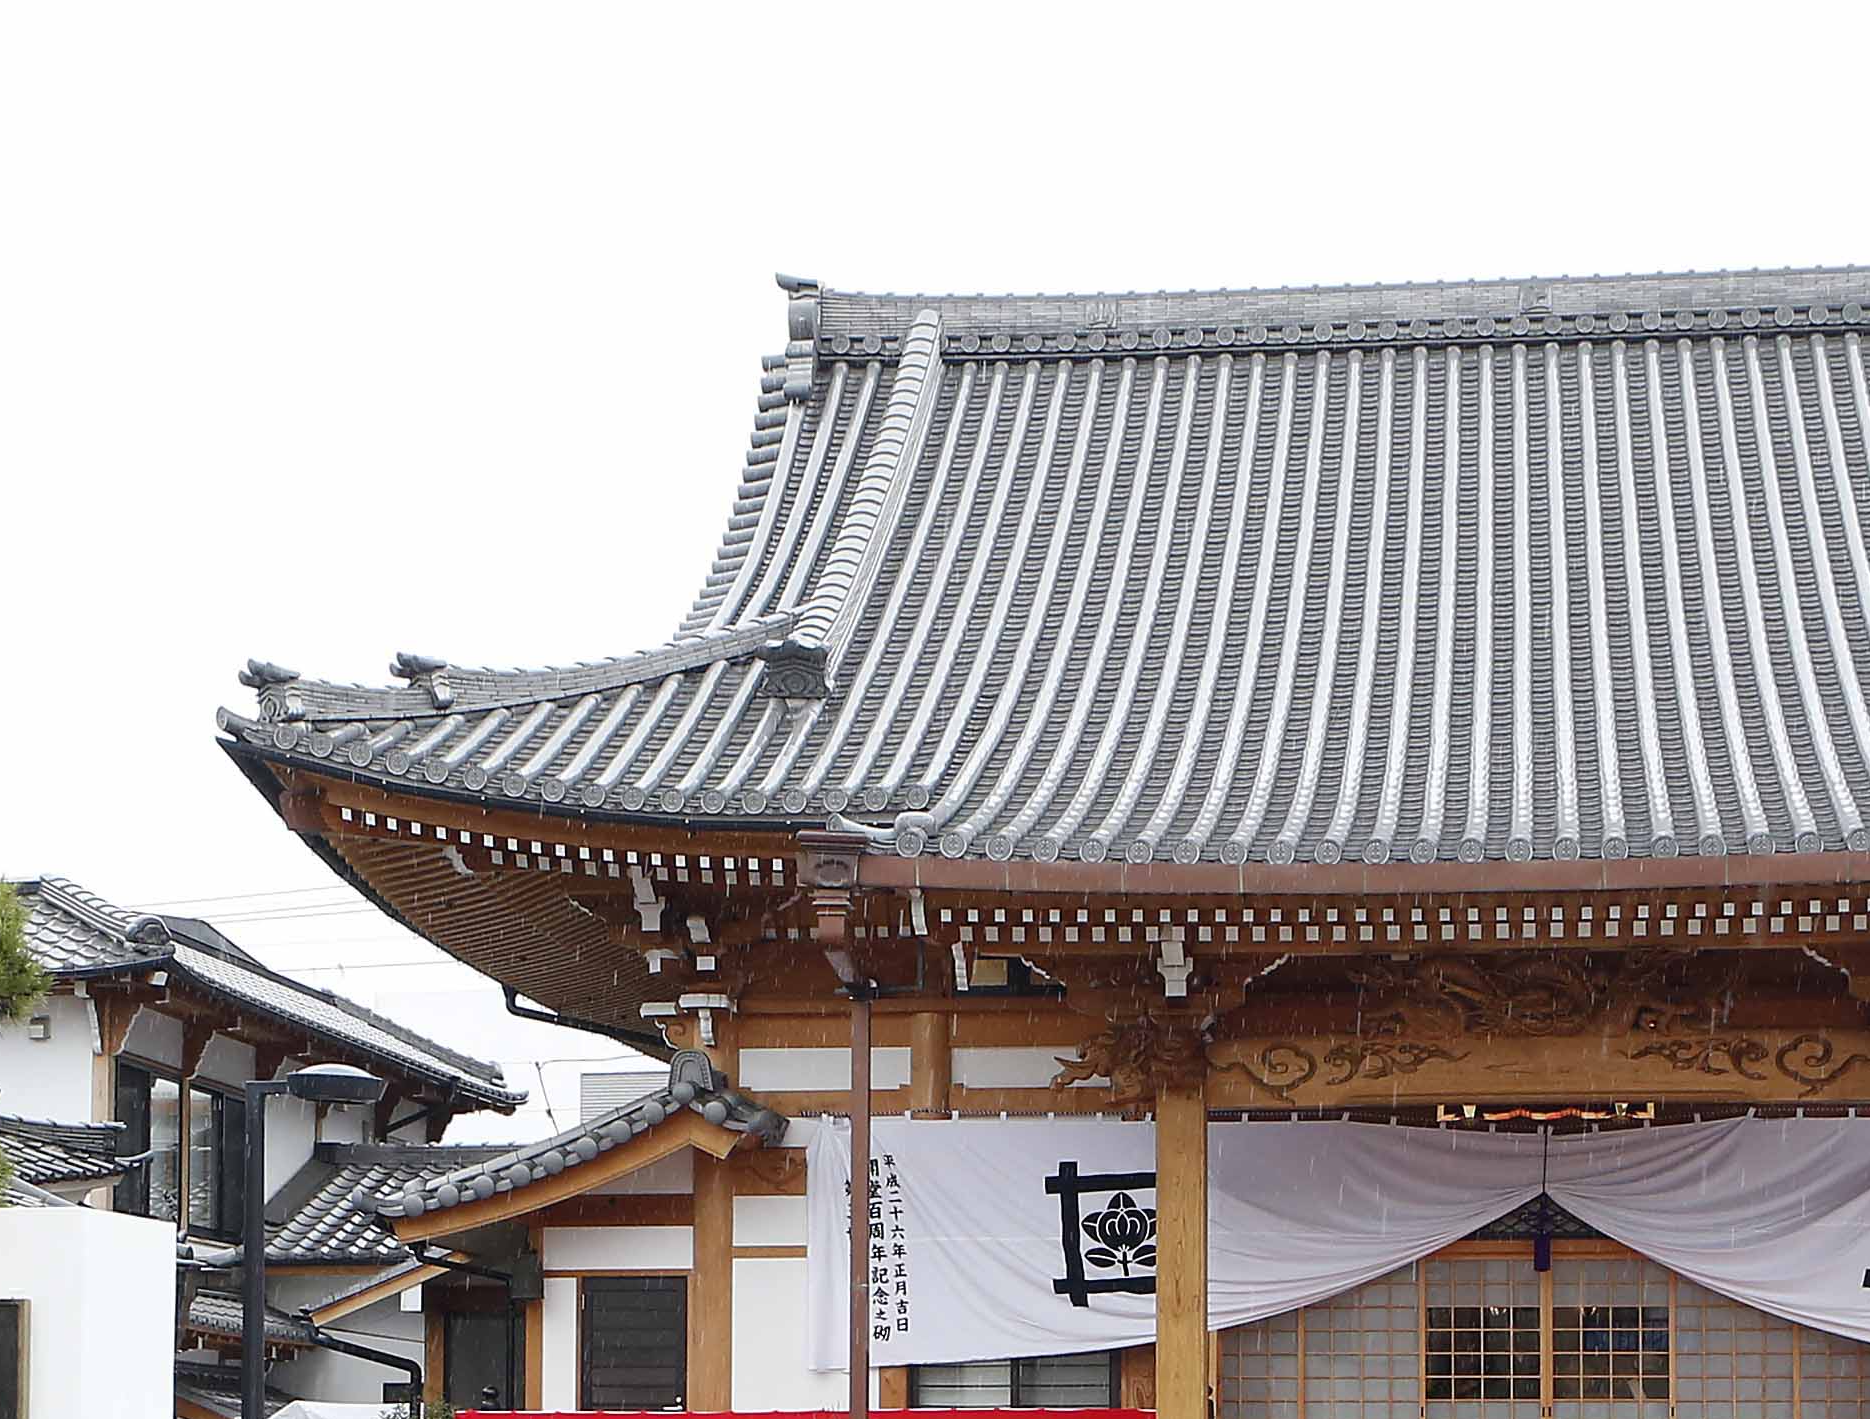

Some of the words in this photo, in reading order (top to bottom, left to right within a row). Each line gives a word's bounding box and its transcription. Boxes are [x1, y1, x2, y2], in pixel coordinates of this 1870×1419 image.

[882, 1154, 909, 1333] 平成二十六年正月吉日
